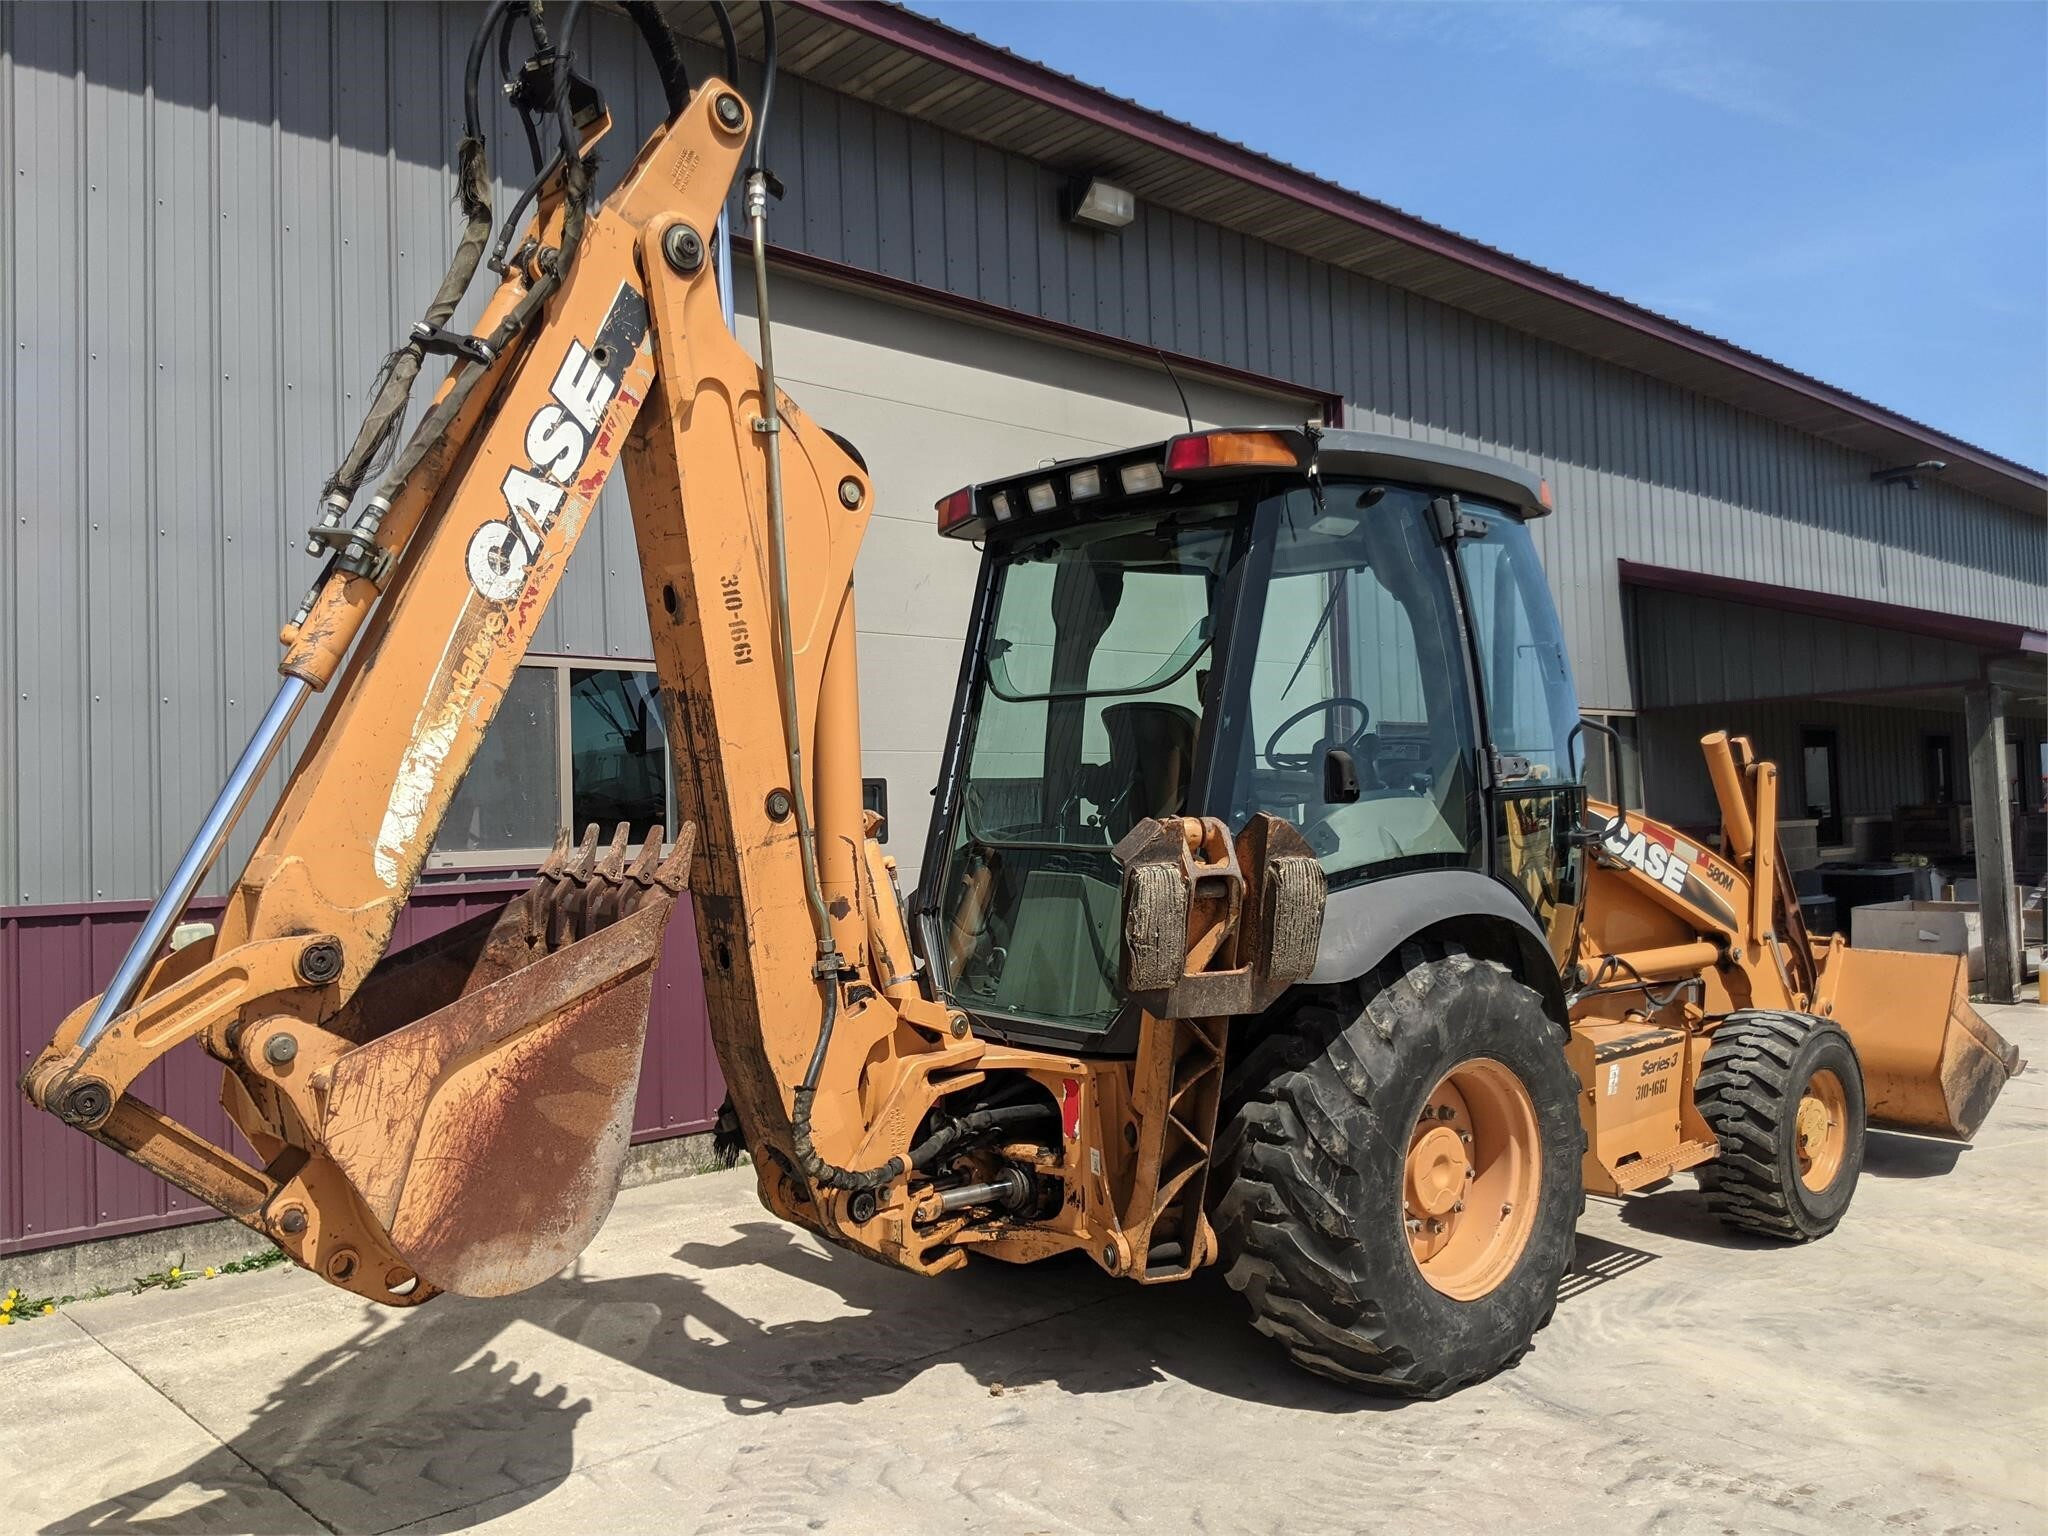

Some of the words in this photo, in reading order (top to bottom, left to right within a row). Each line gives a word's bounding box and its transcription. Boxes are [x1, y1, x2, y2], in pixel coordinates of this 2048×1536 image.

[466, 338, 617, 601] CASE
[720, 574, 753, 665] 310-1661
[1604, 815, 1690, 894] CASE
[1706, 862, 1735, 892] 580M
[1635, 1078, 1668, 1101] 310-1661
[1640, 1056, 1670, 1077] Series
[1670, 1051, 1679, 1068] 3
